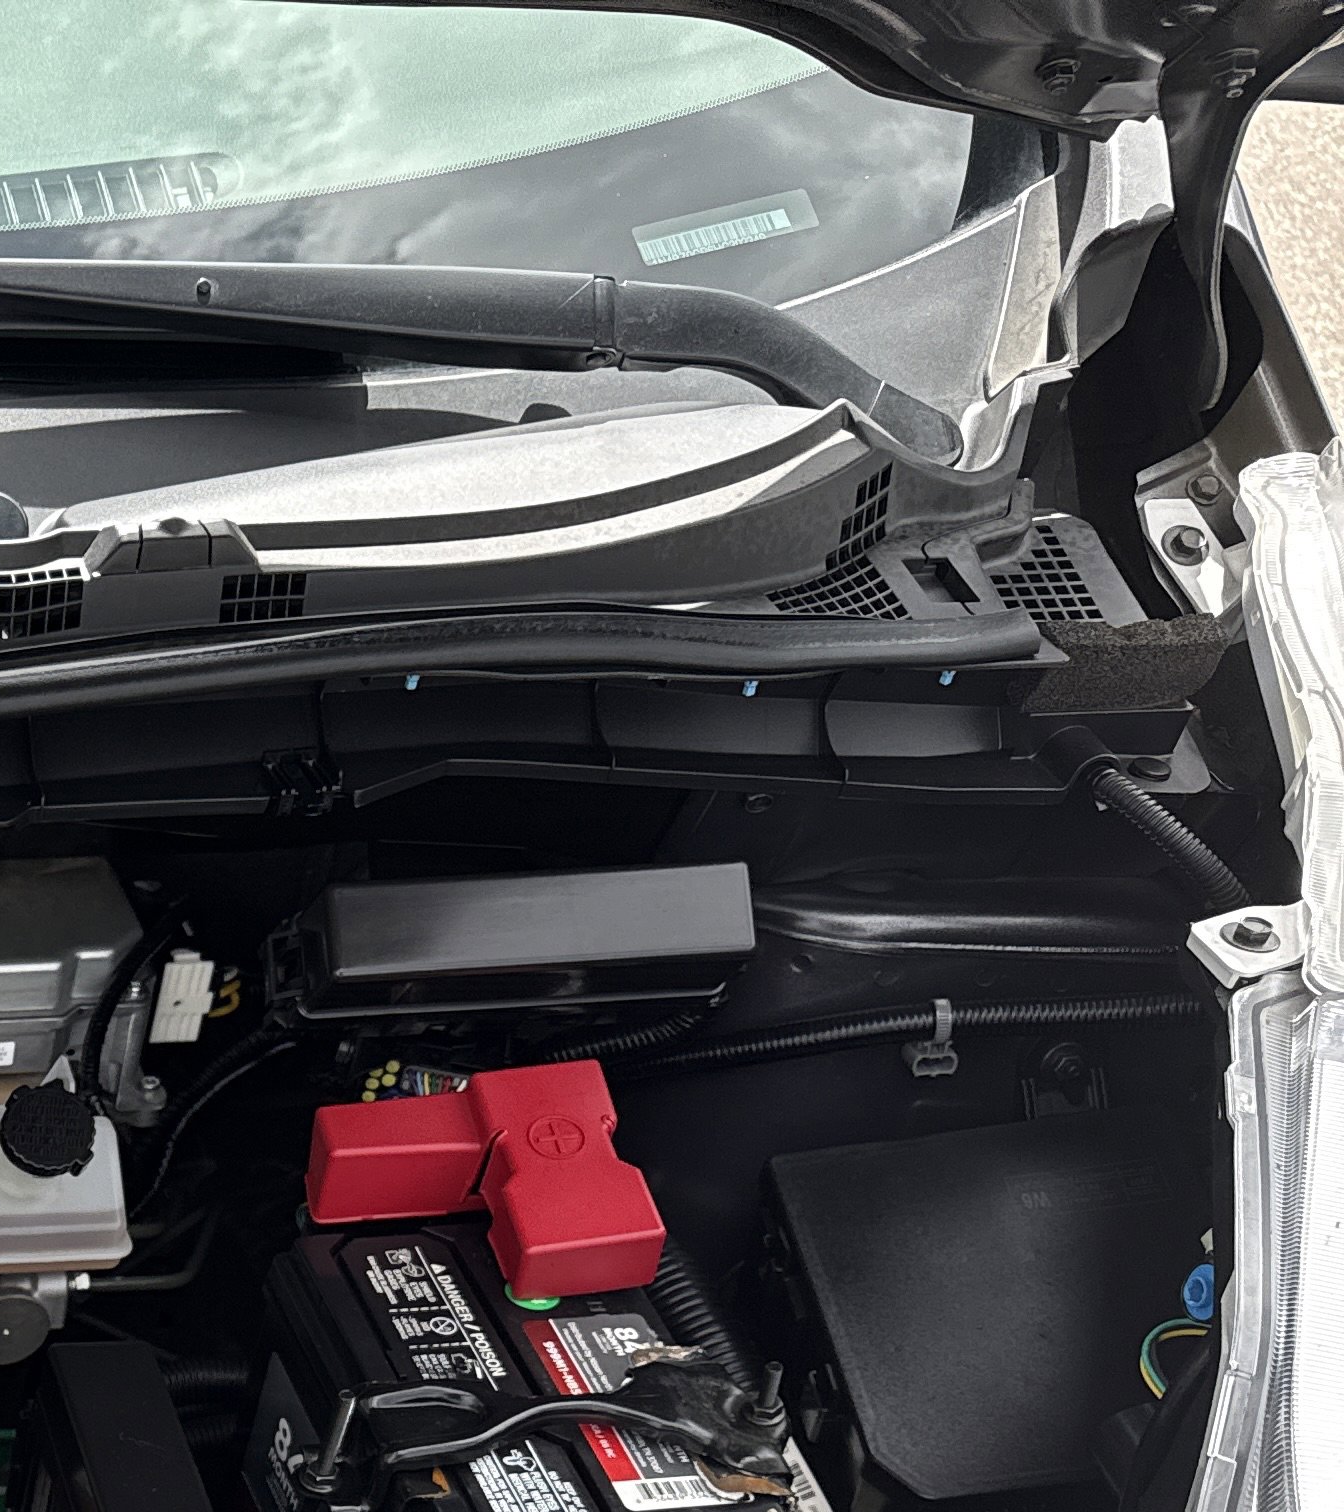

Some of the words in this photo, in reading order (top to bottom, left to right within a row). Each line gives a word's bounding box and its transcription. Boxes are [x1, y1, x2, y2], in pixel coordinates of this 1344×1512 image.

[437, 1275, 474, 1321] DANGER
[470, 1333, 507, 1376] POISON
[602, 1327, 625, 1356] MONTH
[614, 1327, 644, 1354] 84
[268, 1446, 300, 1511] MONTH
